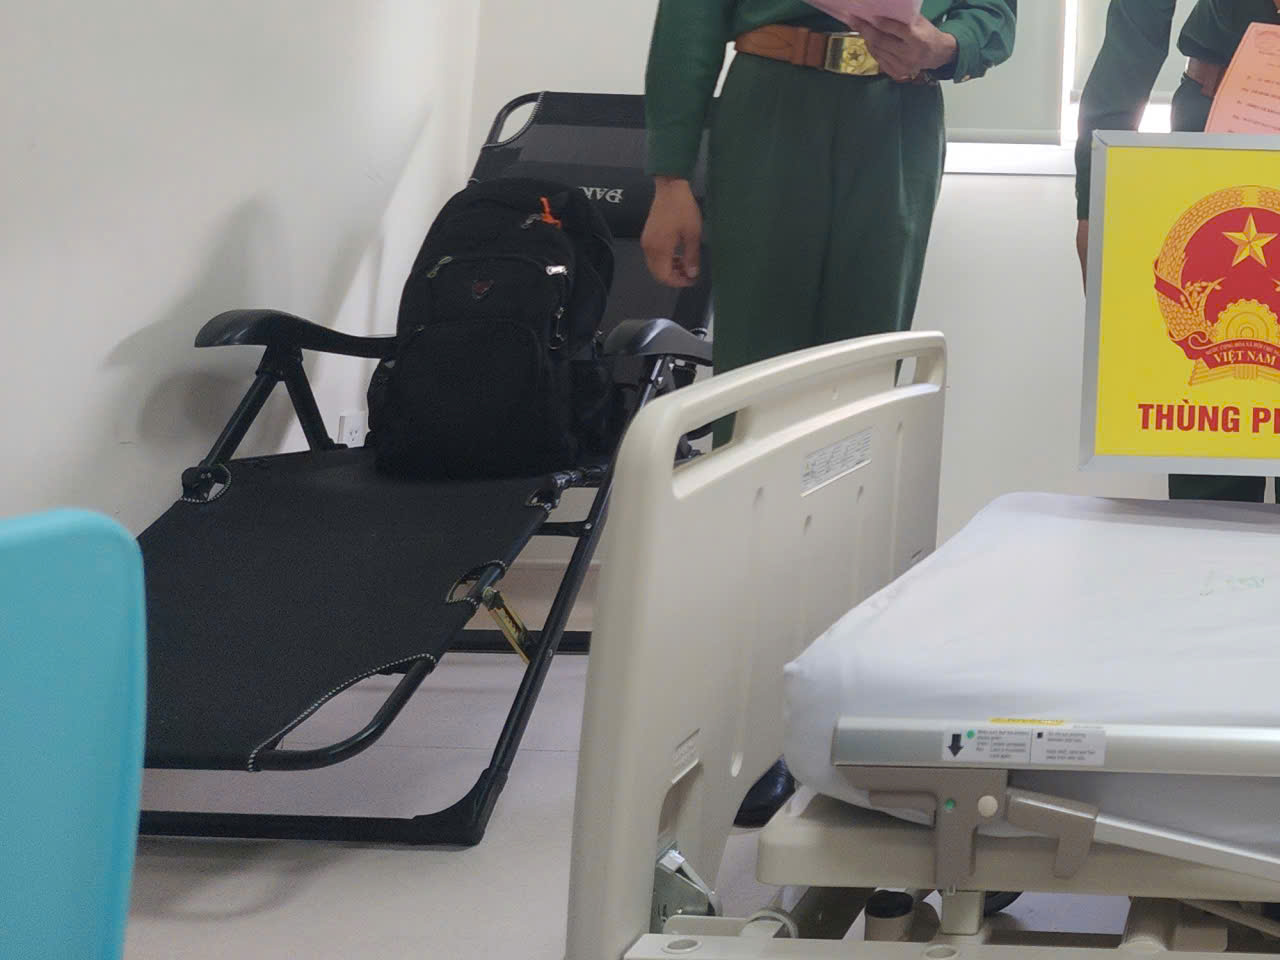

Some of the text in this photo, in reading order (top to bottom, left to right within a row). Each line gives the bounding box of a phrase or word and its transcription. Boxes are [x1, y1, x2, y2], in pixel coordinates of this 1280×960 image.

[1213, 350, 1276, 366] VIỆT NAM
[1138, 399, 1240, 433] THÙNG
